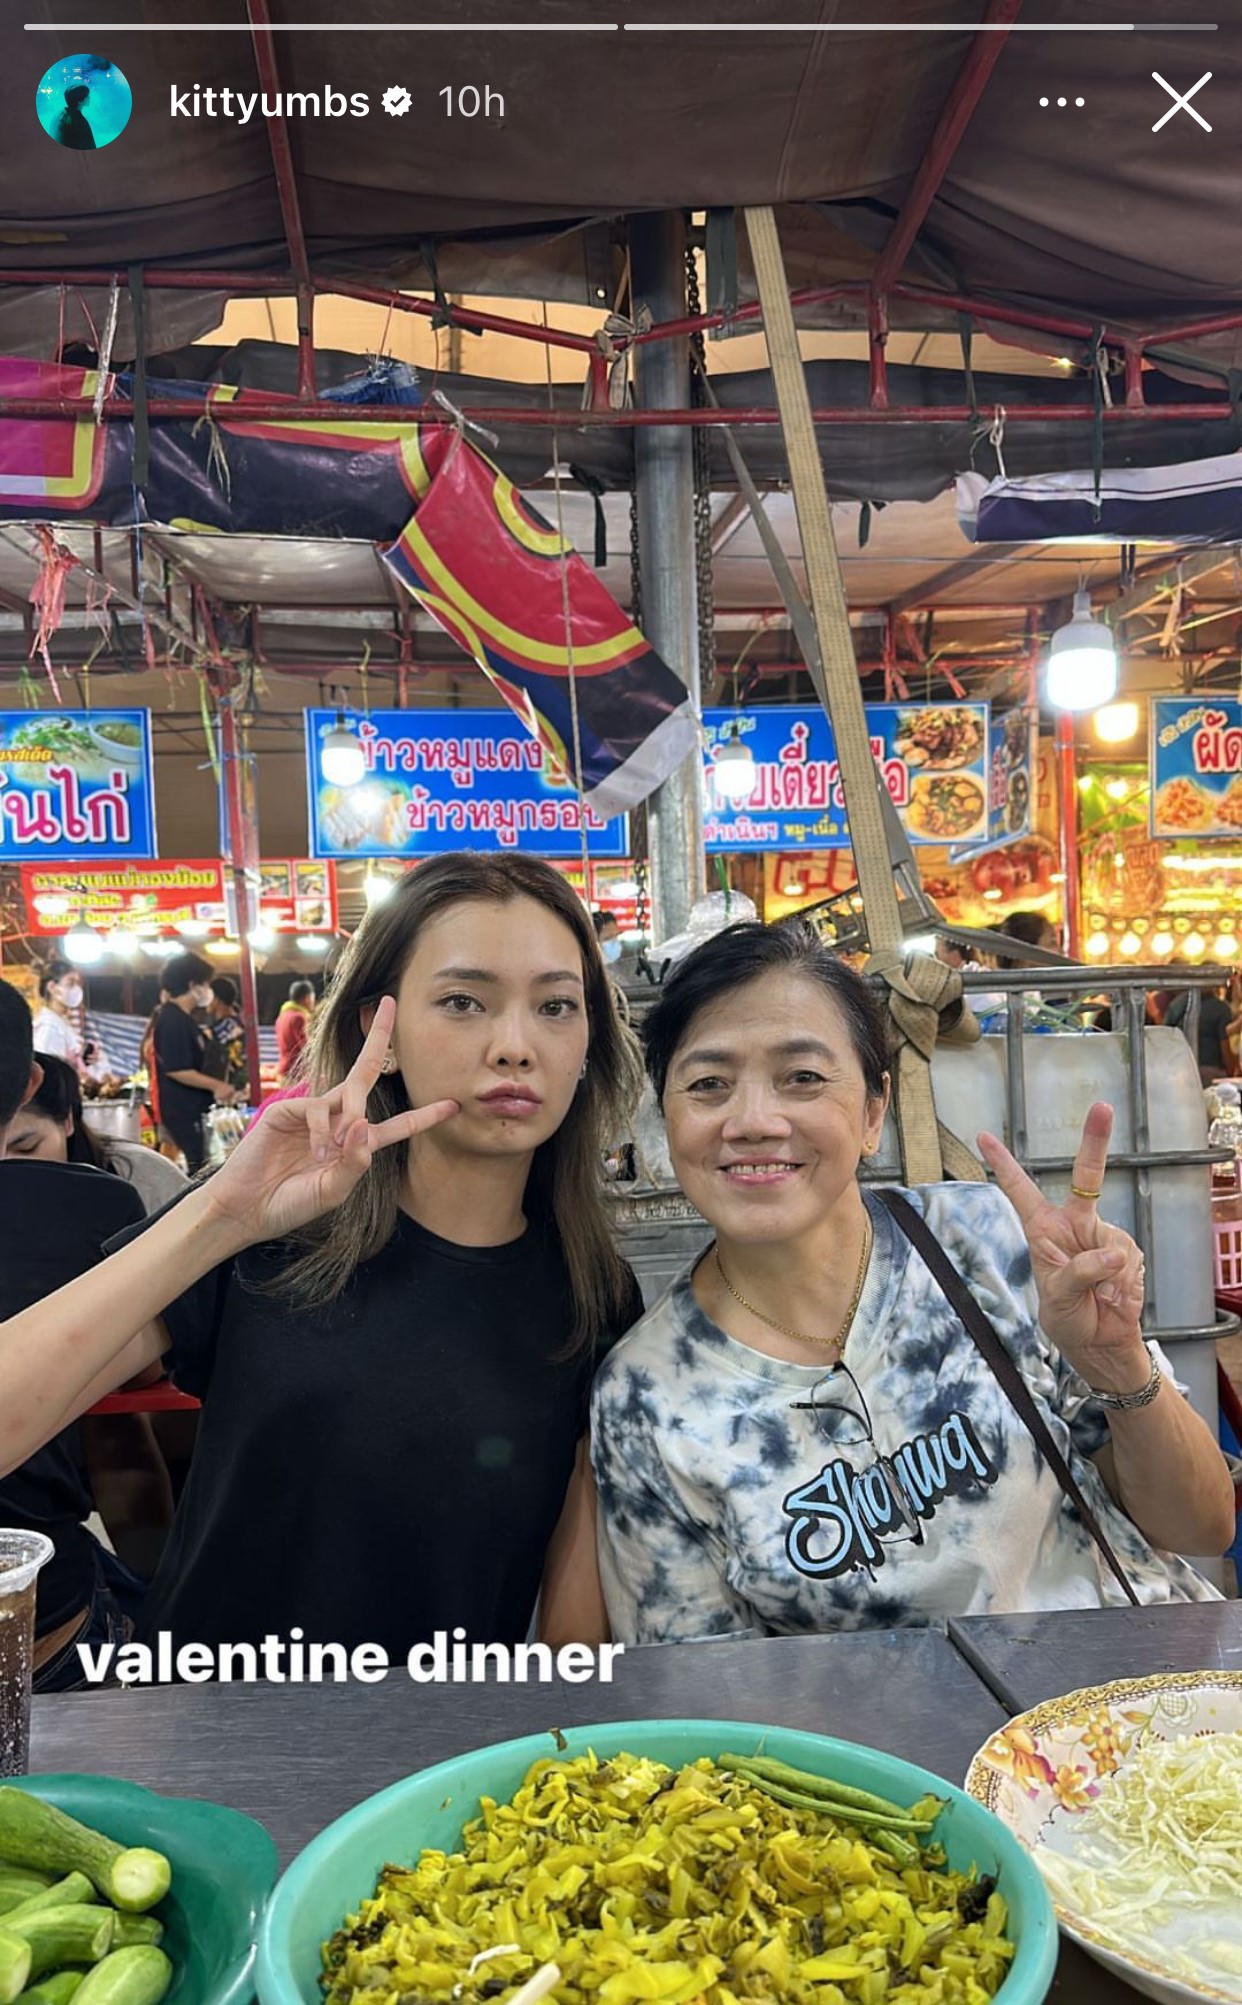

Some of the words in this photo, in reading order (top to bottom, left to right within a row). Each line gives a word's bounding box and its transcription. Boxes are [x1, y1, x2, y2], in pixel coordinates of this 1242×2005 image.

[406, 786, 606, 846] ข้าวหมูกรอบ
